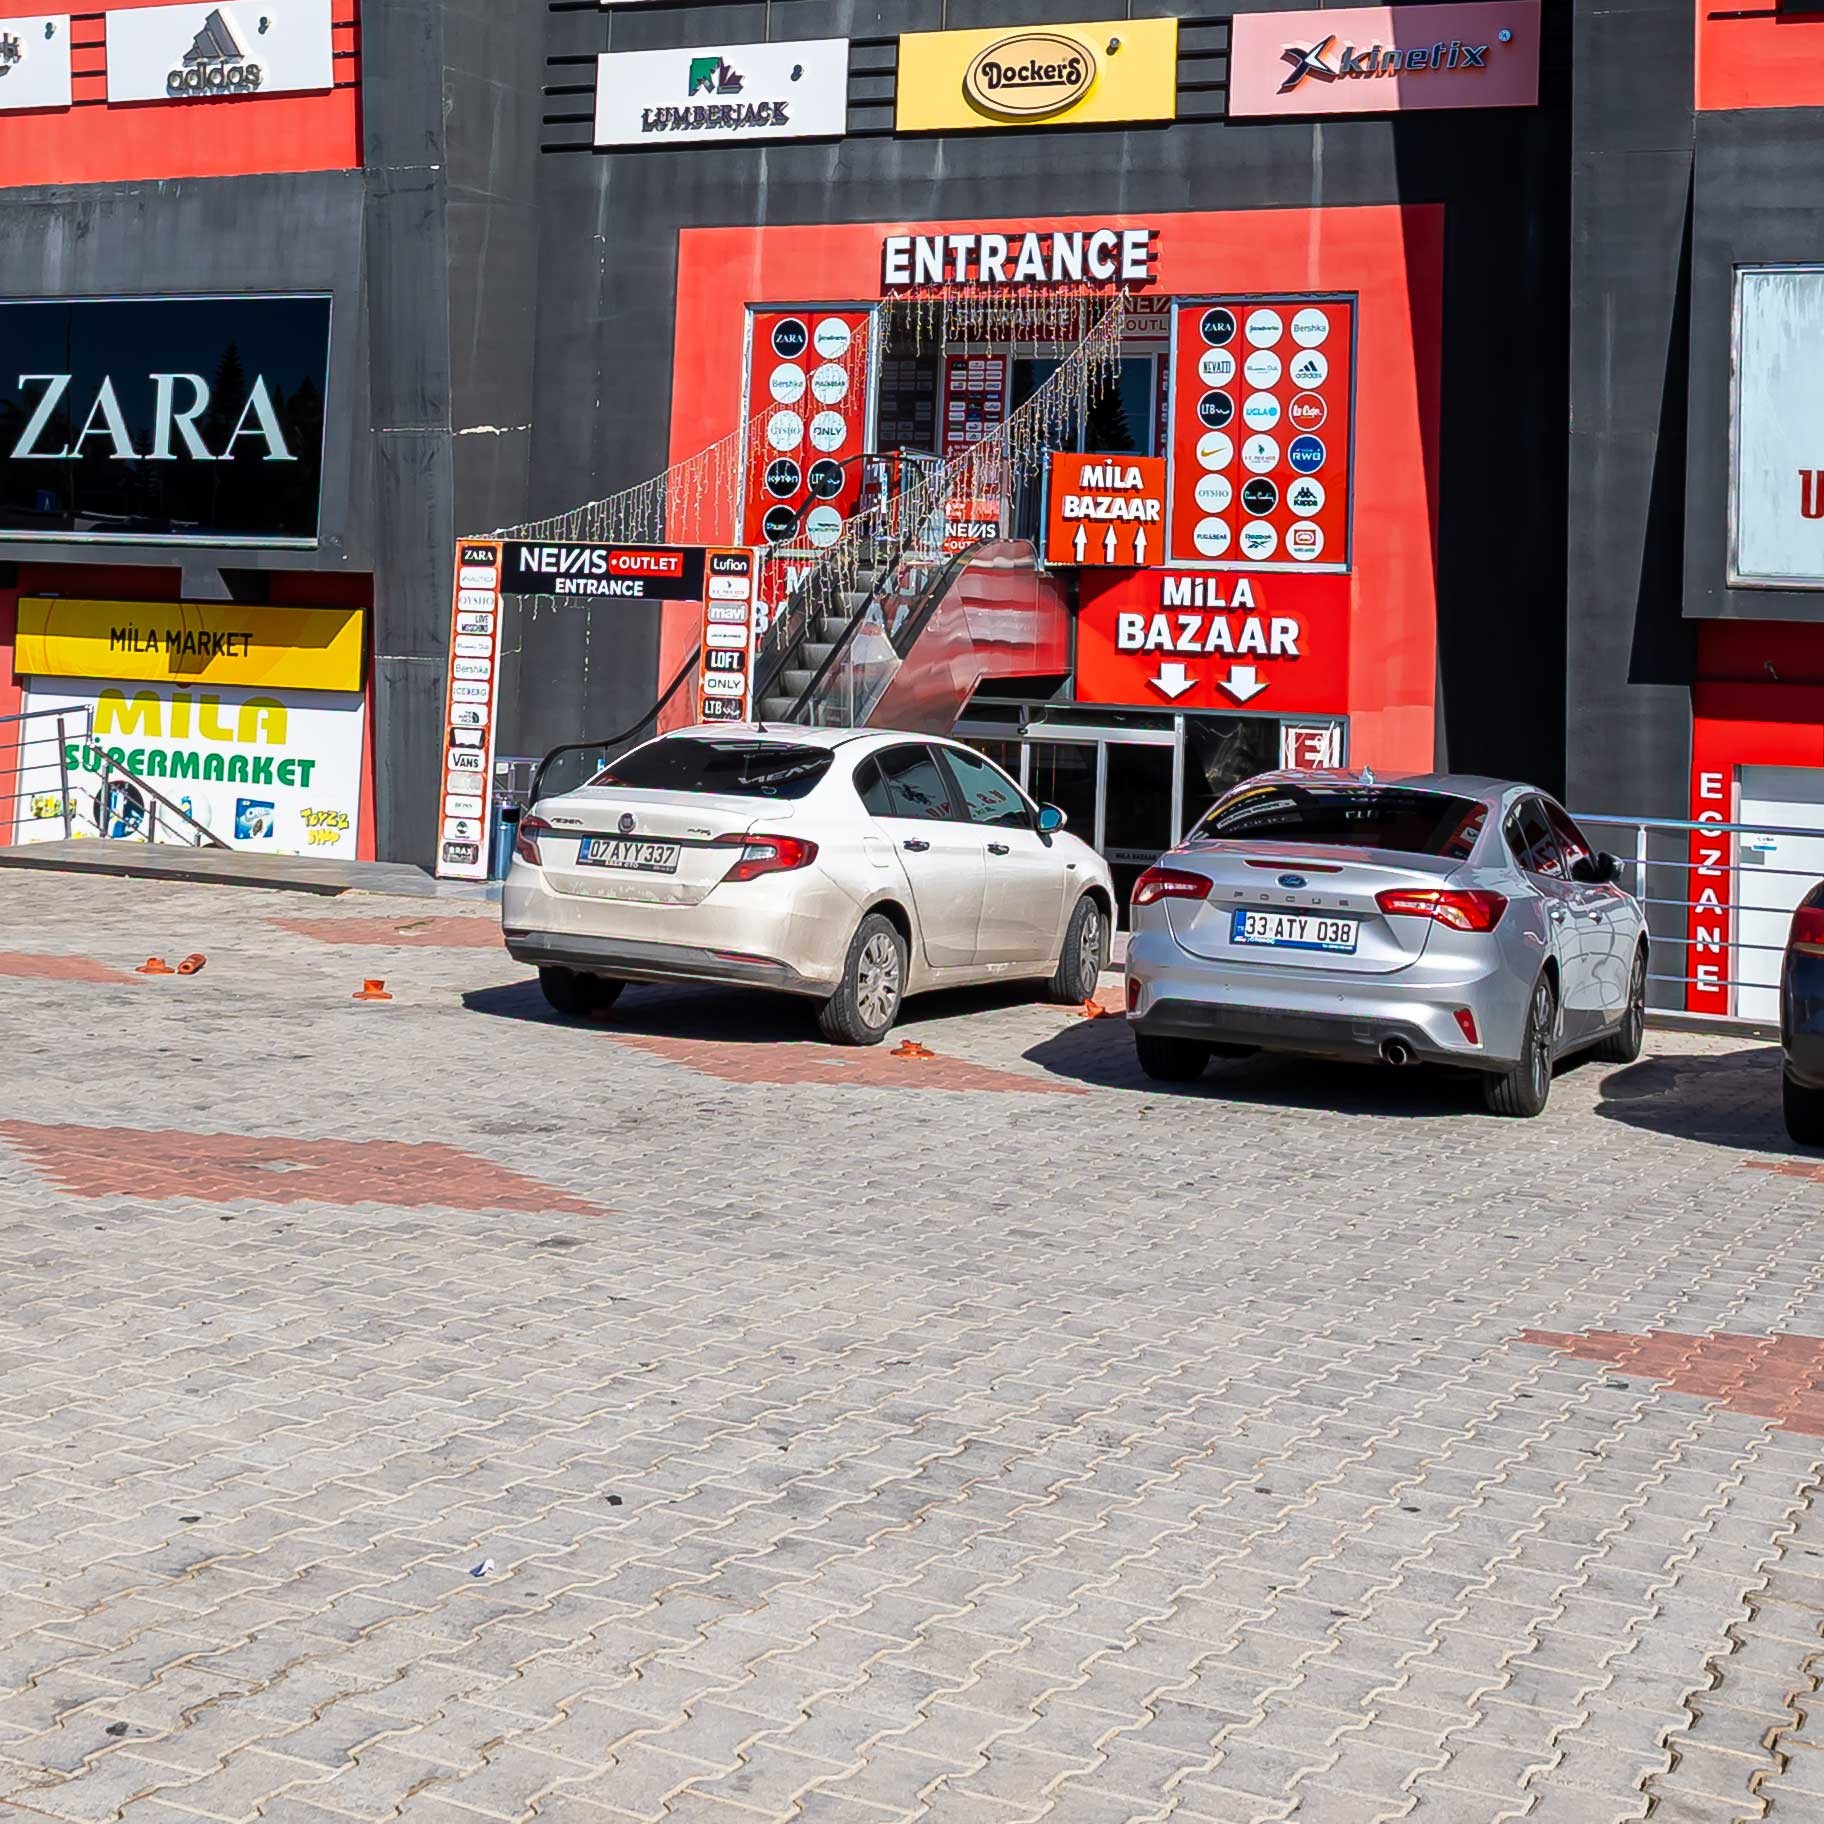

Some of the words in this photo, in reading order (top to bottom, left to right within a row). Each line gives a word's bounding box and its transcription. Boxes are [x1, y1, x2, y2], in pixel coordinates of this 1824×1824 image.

[1339, 40, 1489, 79] kinetix
[166, 60, 262, 96] adidas
[641, 99, 790, 133] LUMBERJACK
[883, 229, 1152, 285] ENTRANCE
[775, 334, 804, 344] ZARA
[1204, 322, 1232, 332] ZARA
[9, 373, 299, 461] ZARA
[1062, 495, 1161, 522] BAZAAR
[945, 523, 997, 539] NEVAS
[464, 549, 494, 561] ZARA
[519, 547, 608, 574] NEVAS
[618, 556, 679, 572] OUTLET
[713, 558, 747, 572] Lufian
[555, 578, 644, 597] ENTRANCE
[710, 605, 746, 621] mavi
[109, 626, 160, 656] MİLA
[166, 629, 254, 659] MARKET
[1116, 612, 1300, 656] BAZAAR
[710, 651, 740, 668] LOFT
[707, 678, 742, 690] ONLY
[704, 700, 723, 715] LTB
[64, 737, 316, 788] SÜPERMARKET
[452, 753, 480, 769] VANS
[1694, 772, 1724, 993] ECZANE
[1244, 915, 1268, 937] 33
[1274, 917, 1310, 940] ATY
[1316, 922, 1351, 943] 038
